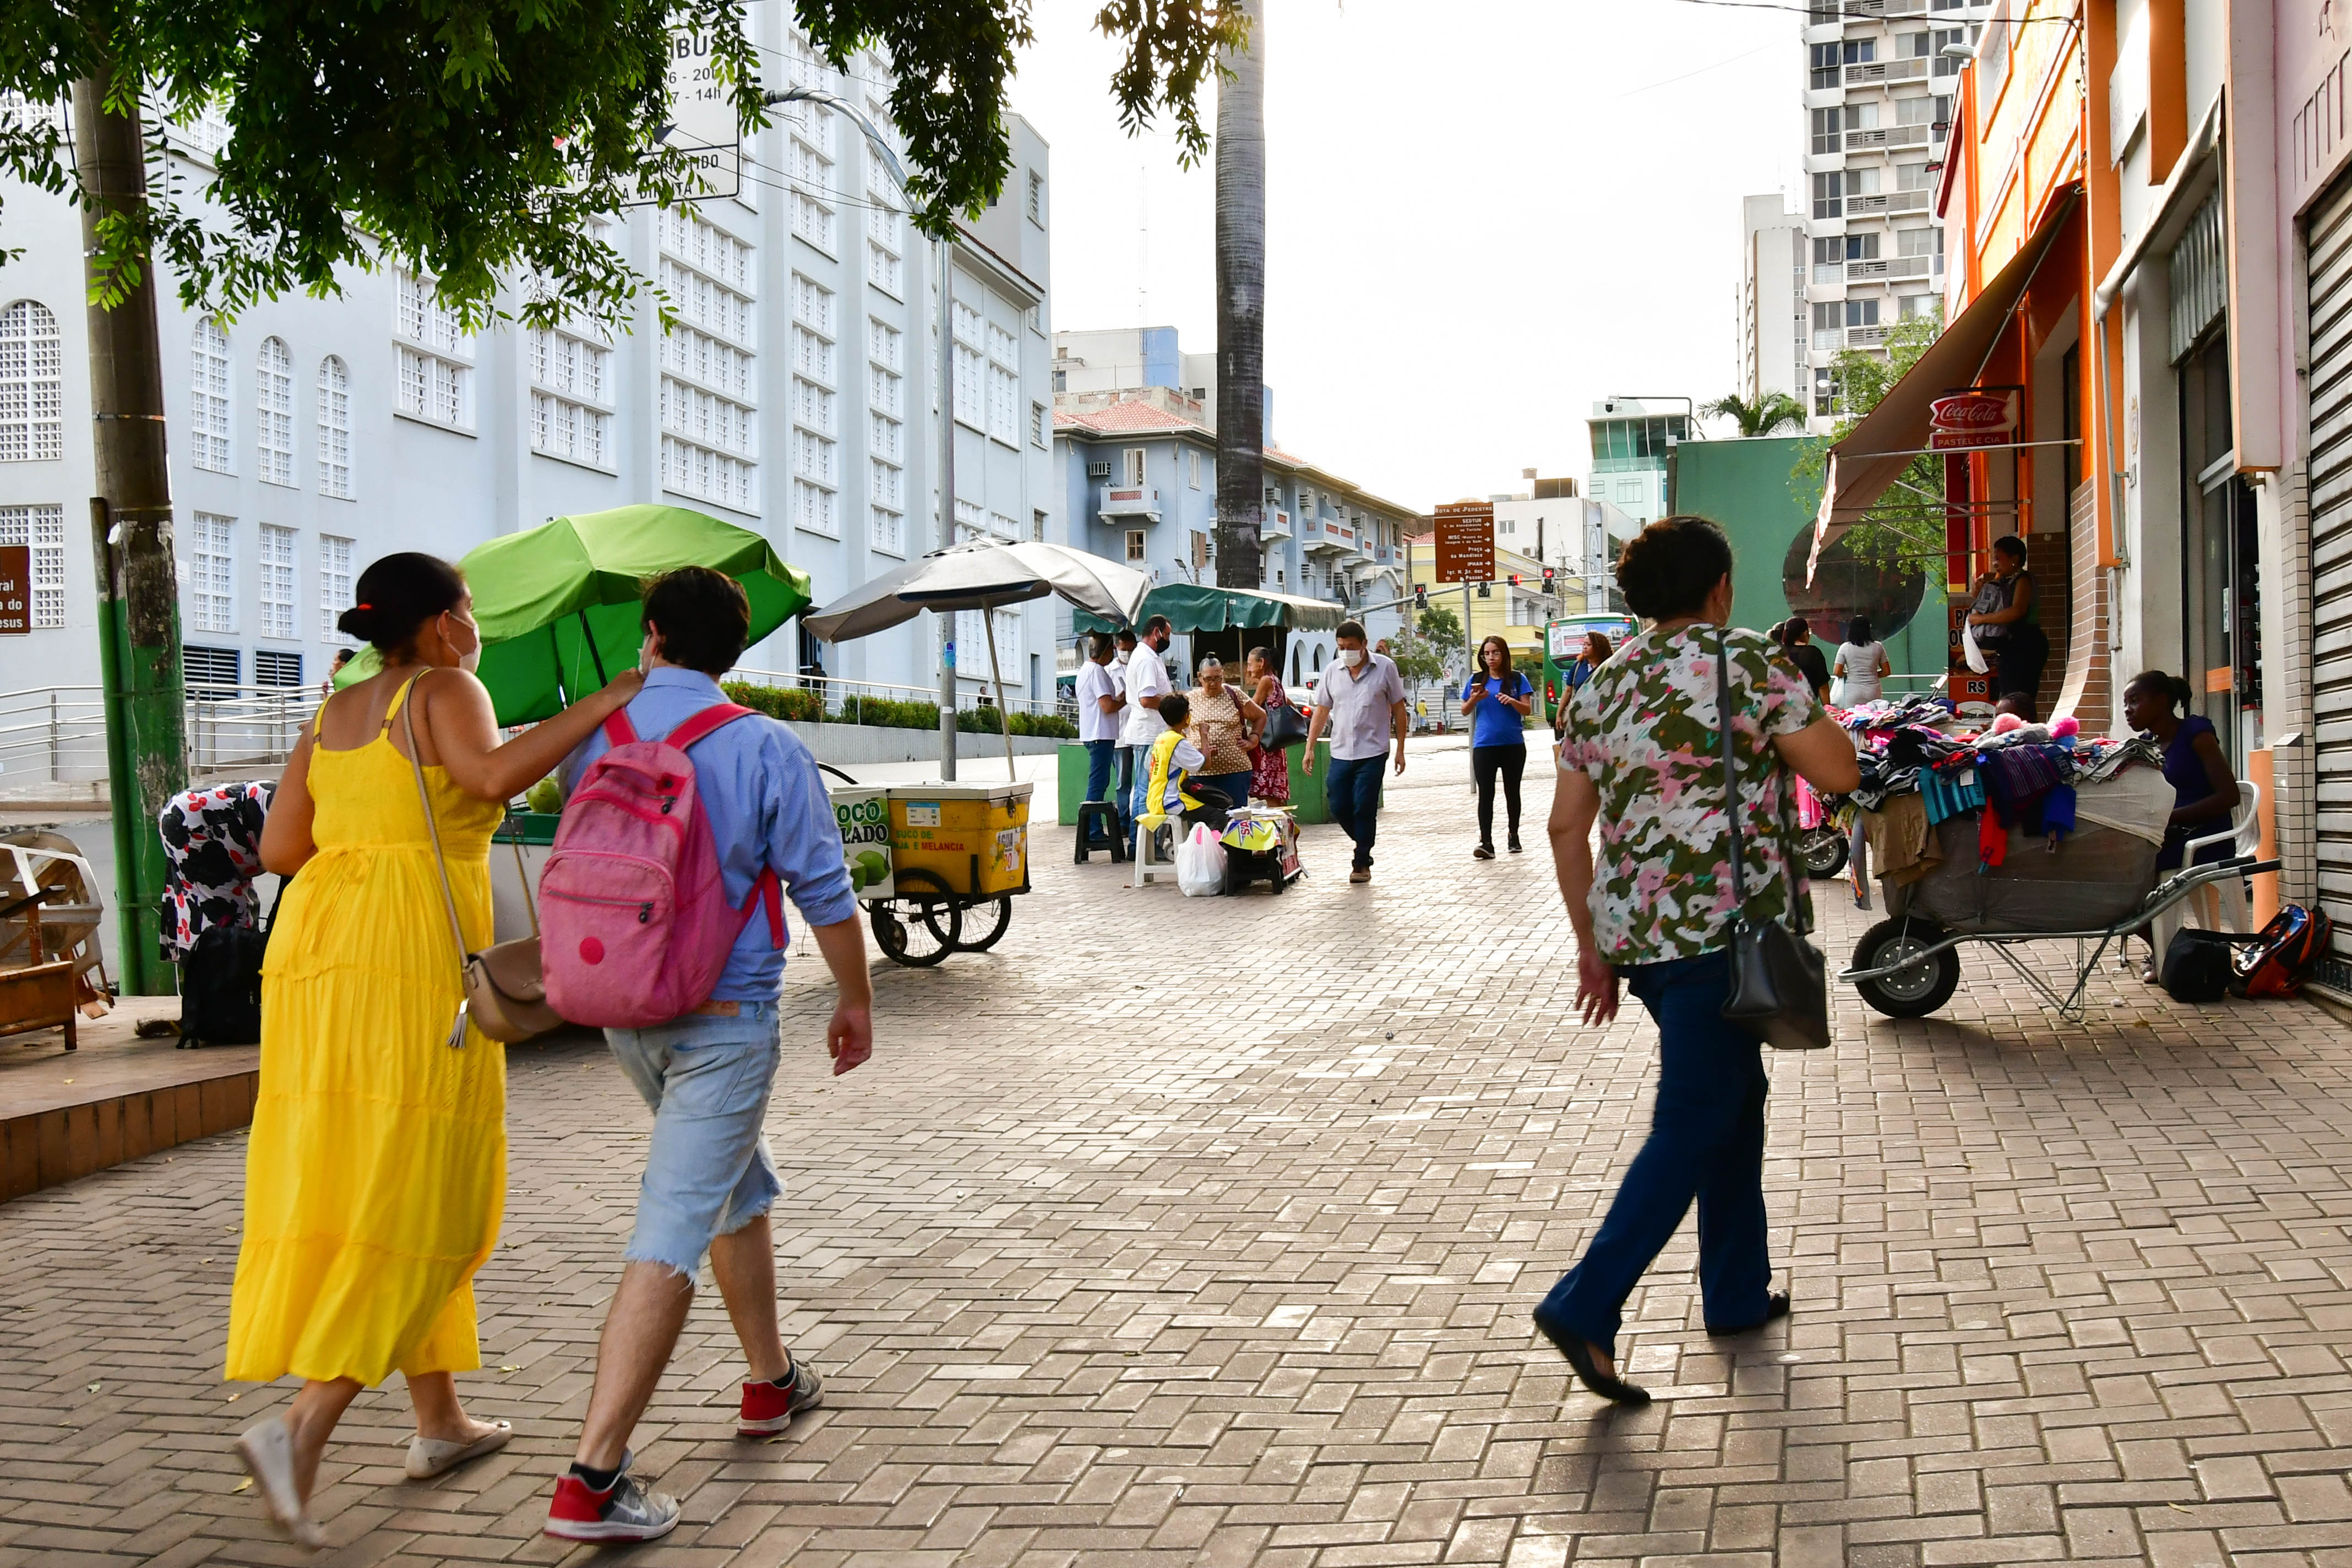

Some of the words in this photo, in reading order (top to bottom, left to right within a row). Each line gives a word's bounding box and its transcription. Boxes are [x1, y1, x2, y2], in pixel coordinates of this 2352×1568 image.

[695, 87, 721, 101] 14h
[1940, 402, 2000, 421] Coca-Cola
[1937, 438, 1973, 447] PASTEL
[8, 598, 23, 611] do
[834, 802, 880, 823] OCO
[896, 830, 918, 839] SUCO
[921, 831, 934, 839] DE:
[922, 842, 965, 851] MELANCIA
